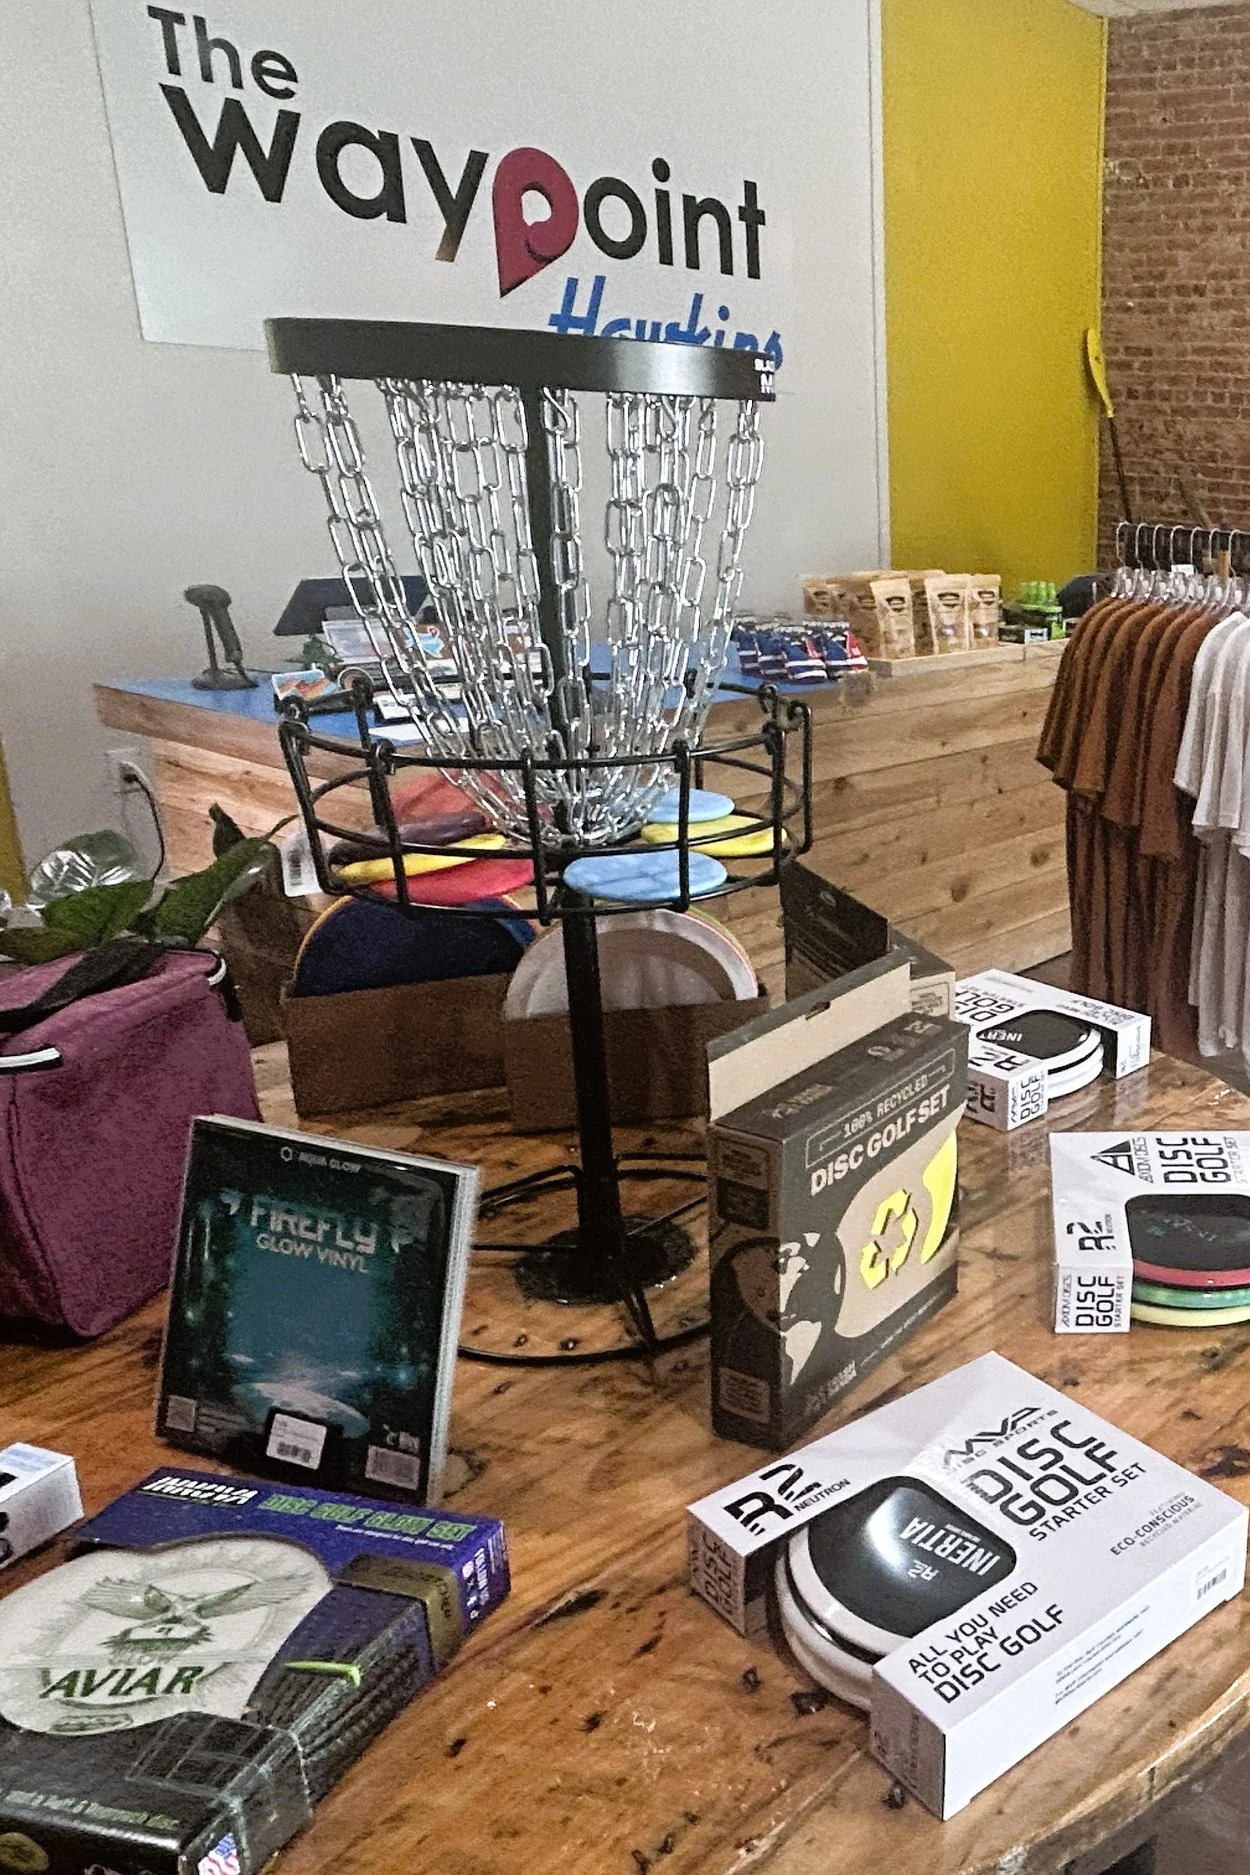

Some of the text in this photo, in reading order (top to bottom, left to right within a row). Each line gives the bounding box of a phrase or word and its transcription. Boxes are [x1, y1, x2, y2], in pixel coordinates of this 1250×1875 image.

[147, 5, 298, 100] The
[159, 82, 766, 298] Waypoint
[955, 1000, 998, 1022] DIS
[843, 1112, 874, 1140] 100%
[876, 1073, 929, 1118] RECYCLED
[1020, 1074, 1036, 1120] DISC
[1029, 1074, 1042, 1115] GOLF
[810, 1143, 866, 1197] DISC
[866, 1105, 920, 1159] GOLF
[917, 1084, 951, 1124] SET
[1156, 1137, 1199, 1184] DISC
[1191, 1137, 1232, 1184] GOLF
[250, 1202, 379, 1256] FIREFLY
[256, 1233, 369, 1275] GLOW VINYL
[1075, 1275, 1097, 1327] DISC
[1096, 1275, 1116, 1327] GOLF
[1114, 1292, 1123, 1328] STARTER
[943, 1406, 1043, 1466] MVP
[992, 1409, 1059, 1448] SPORTS
[961, 1420, 1098, 1506] DISC
[999, 1441, 1118, 1527] GOLF
[794, 1478, 852, 1513] NEUTRON
[1029, 1485, 1114, 1542] STARTER
[1111, 1462, 1148, 1488] SET
[899, 1516, 1002, 1577] INERTIA
[1110, 1495, 1196, 1556] ECO-CONSCIOUS
[908, 1581, 1040, 1676] ALL YOU NEED
[918, 1626, 1000, 1685] TO PLAY
[933, 1652, 1002, 1705] DISC
[999, 1603, 1065, 1658] GOLF
[39, 1665, 205, 1699] AVIAR
